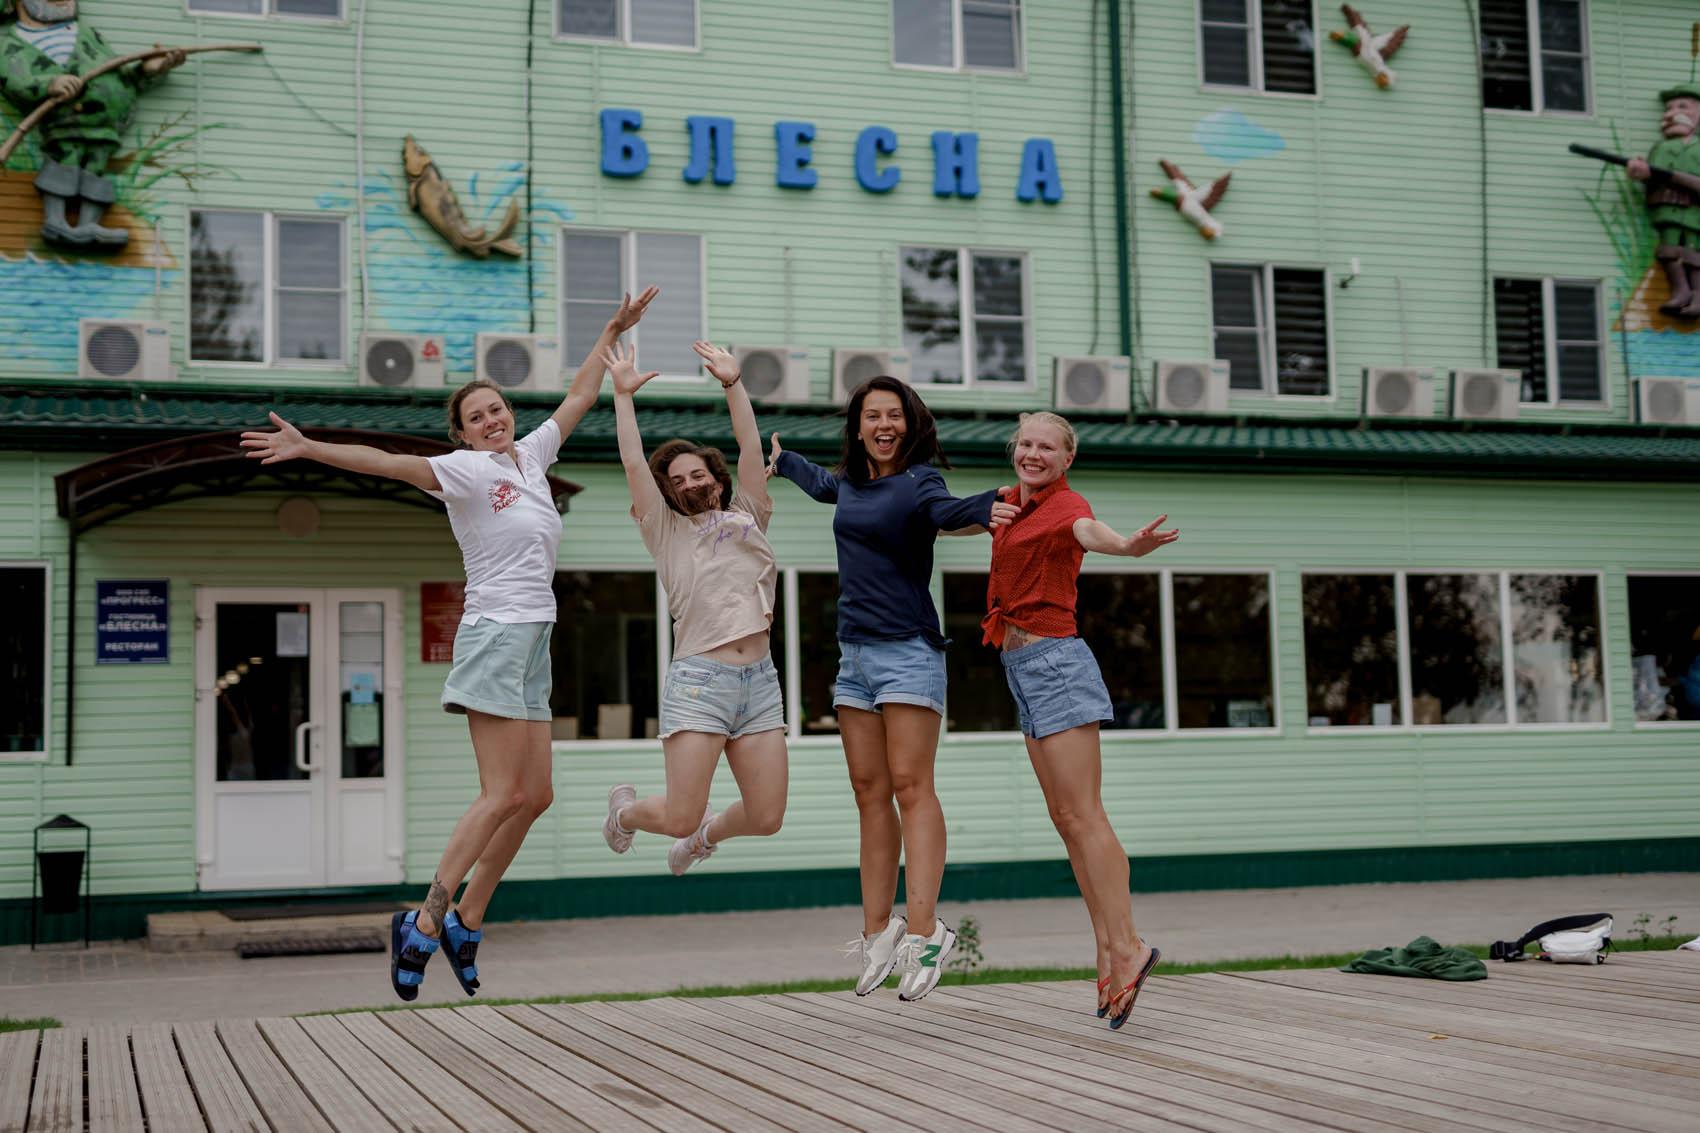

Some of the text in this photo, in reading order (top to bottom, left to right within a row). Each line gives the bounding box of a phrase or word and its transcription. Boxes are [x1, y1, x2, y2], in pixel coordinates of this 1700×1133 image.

[600, 108, 1064, 205] БЛЕСНА
[98, 620, 167, 632] «БЛЕСНА»
[105, 642, 158, 651] РЕСТОРАН
